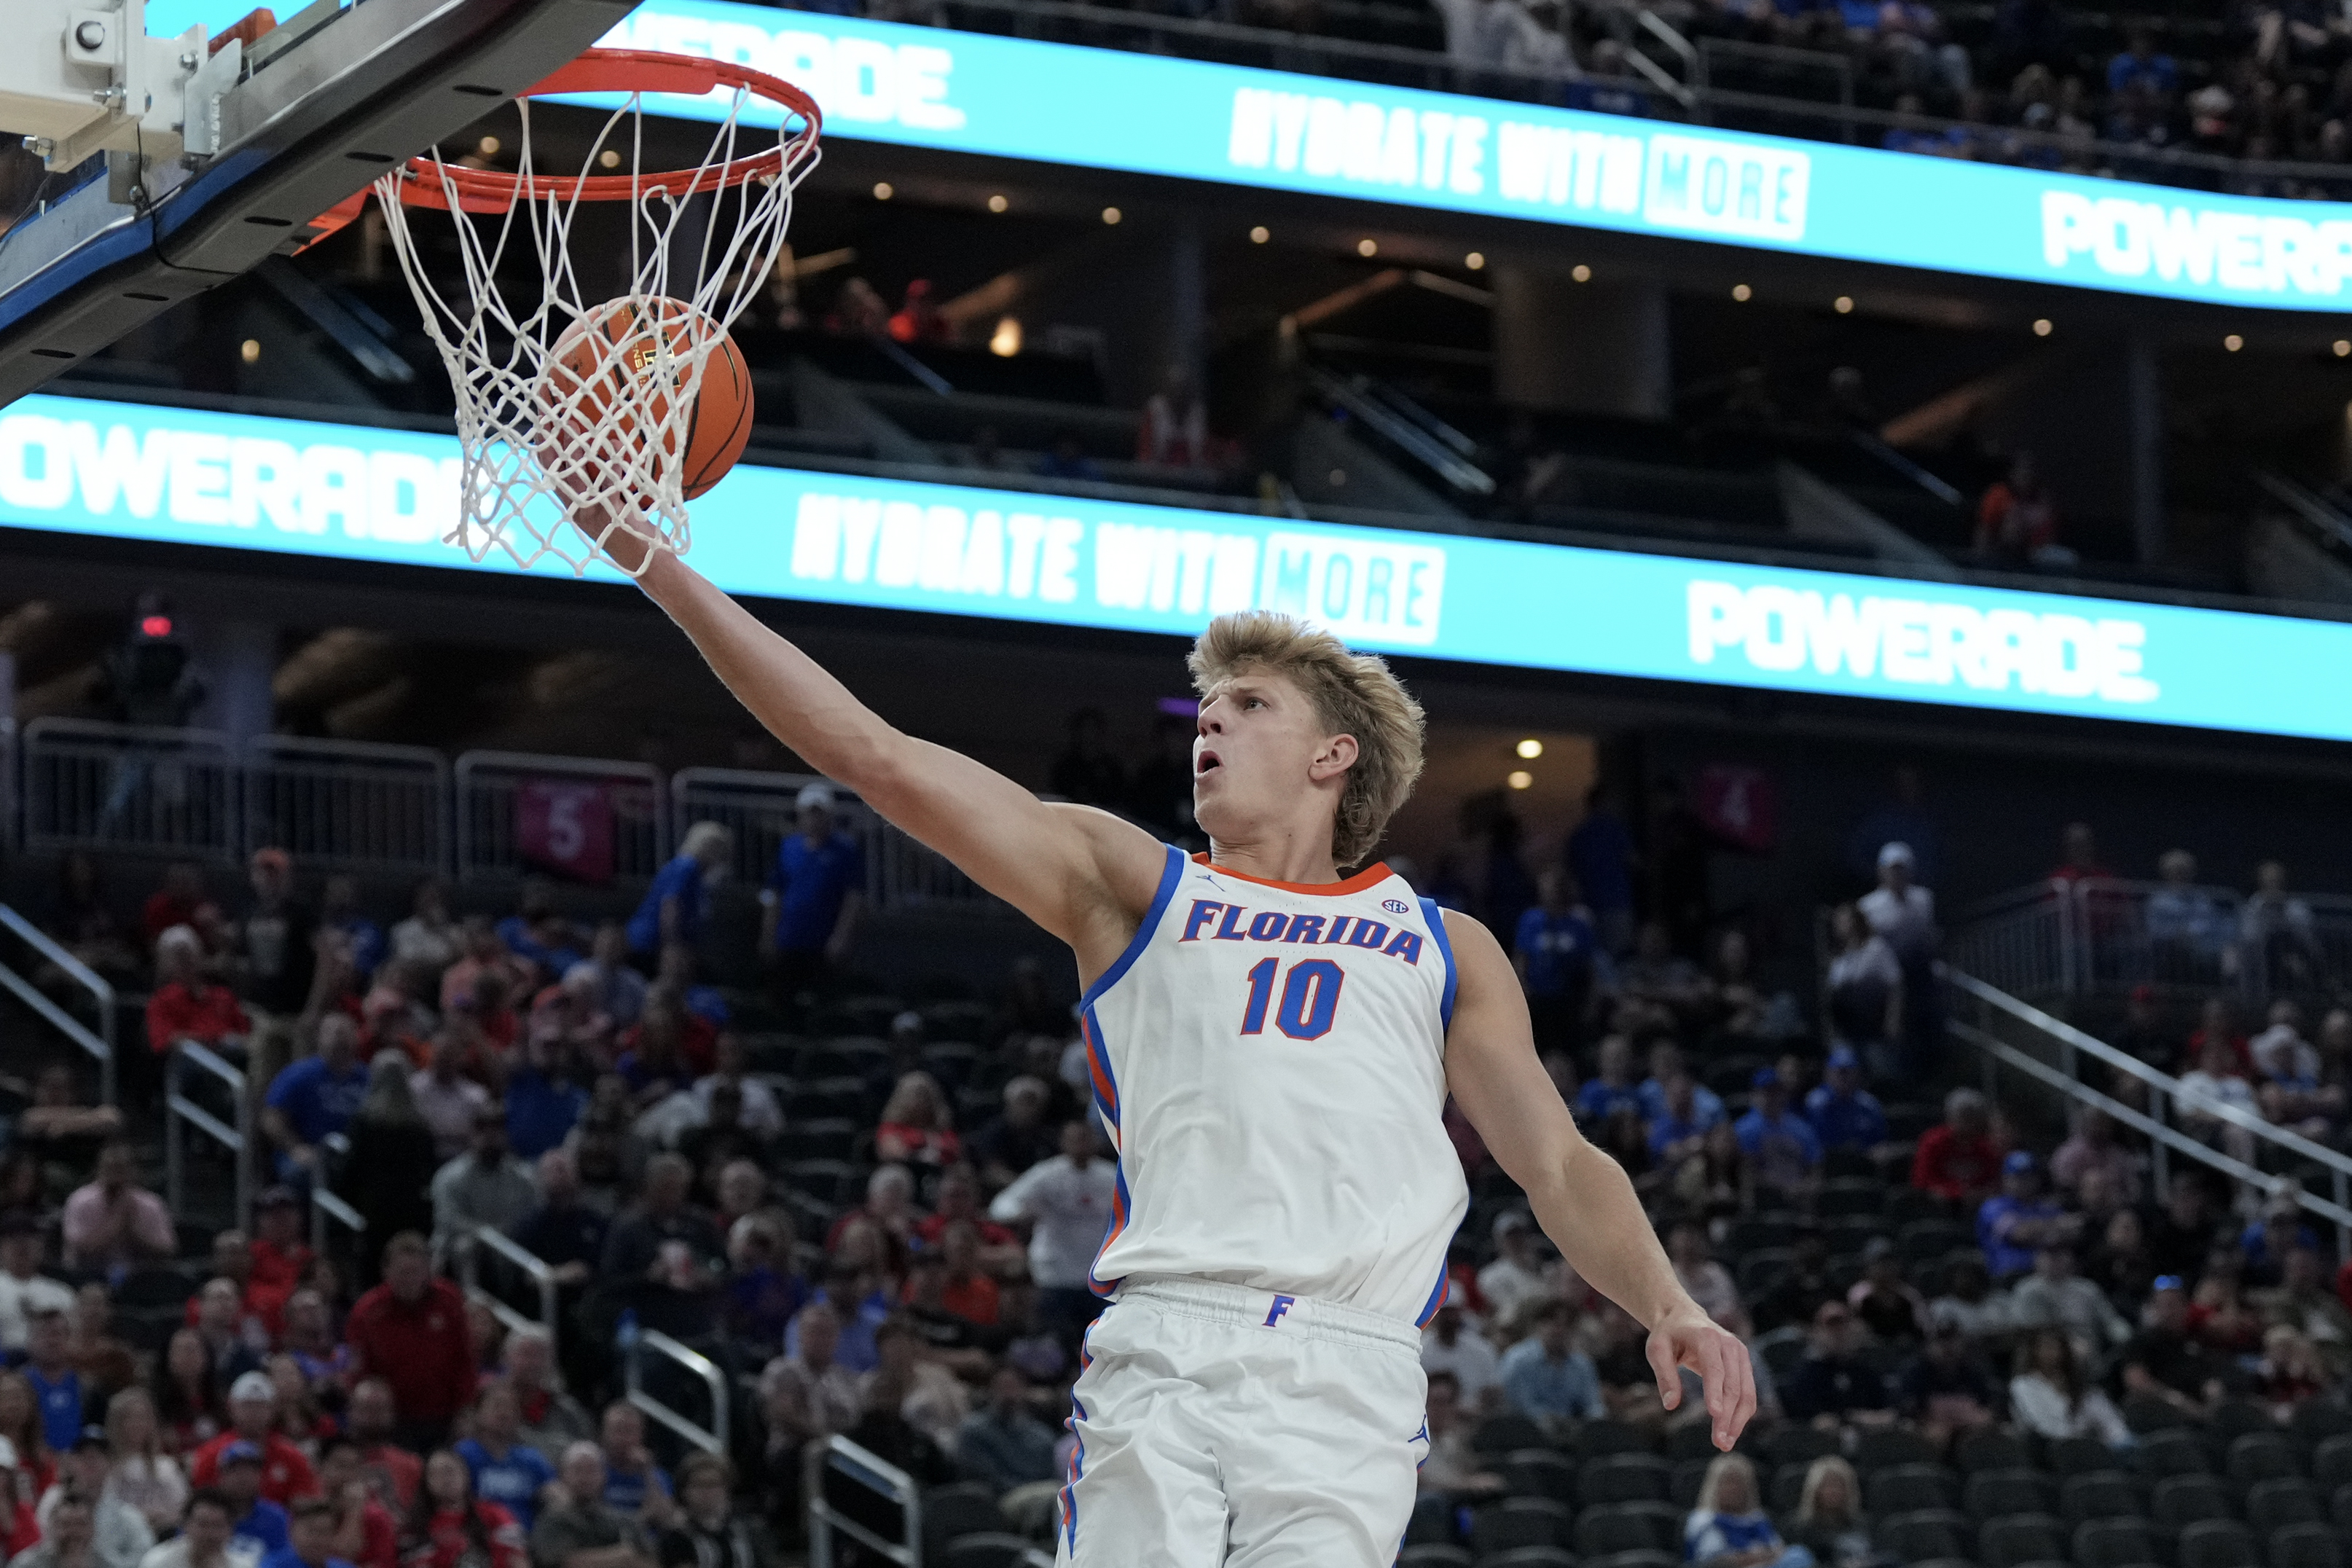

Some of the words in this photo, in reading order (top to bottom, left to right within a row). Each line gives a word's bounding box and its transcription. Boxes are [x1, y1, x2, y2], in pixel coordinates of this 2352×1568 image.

[1228, 87, 1488, 195] HYDRATE
[1497, 121, 1643, 213] WITH
[1658, 150, 1795, 224] MORE
[791, 493, 1083, 603] HYDRATE
[1095, 522, 1258, 617] WITH
[1275, 548, 1430, 627] MORE
[1687, 580, 2160, 702] POWERADE
[547, 797, 582, 861] 5
[1178, 899, 1424, 968] FLORIDA
[1384, 900, 1408, 914] SEC
[1240, 957, 1346, 1041] 10
[1261, 1294, 1295, 1328] F
